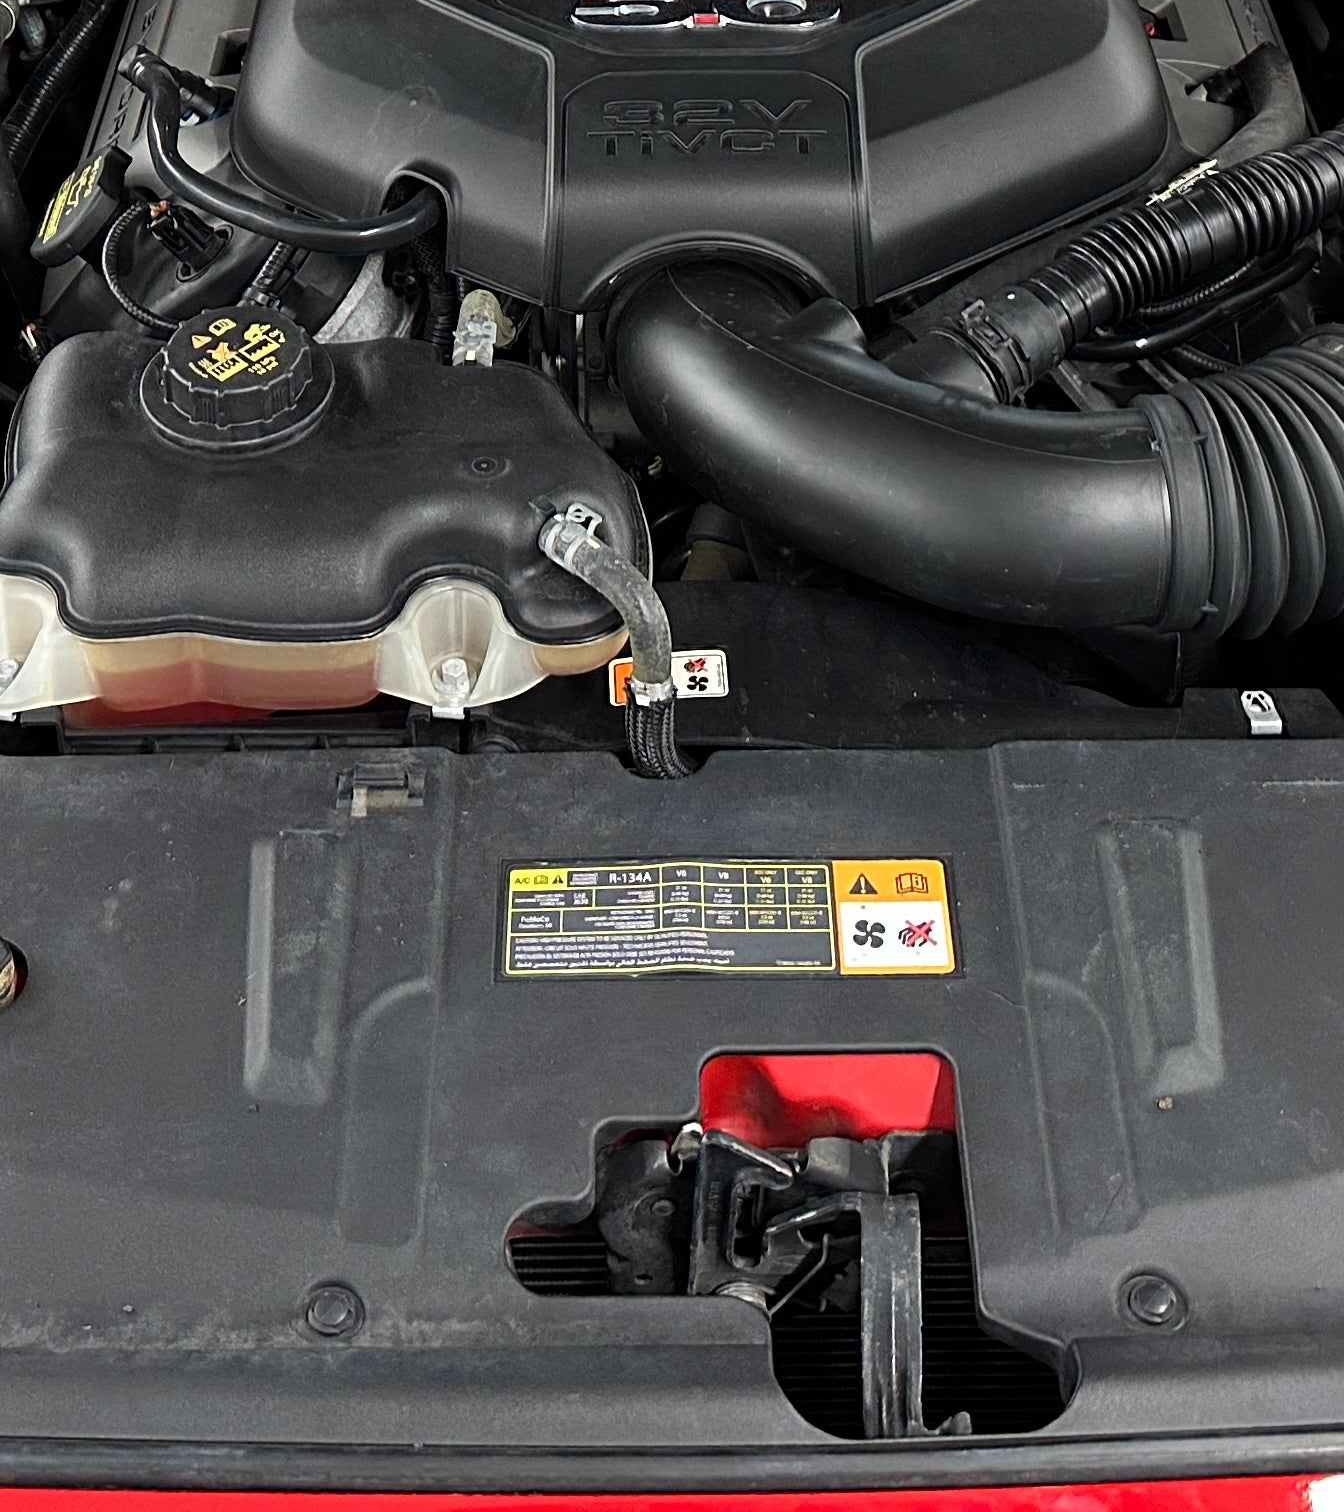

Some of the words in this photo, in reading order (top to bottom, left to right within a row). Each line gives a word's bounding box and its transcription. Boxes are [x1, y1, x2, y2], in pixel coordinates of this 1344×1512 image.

[602, 98, 813, 127] 32V
[514, 877, 531, 885] A/C
[608, 871, 653, 884] R-134A
